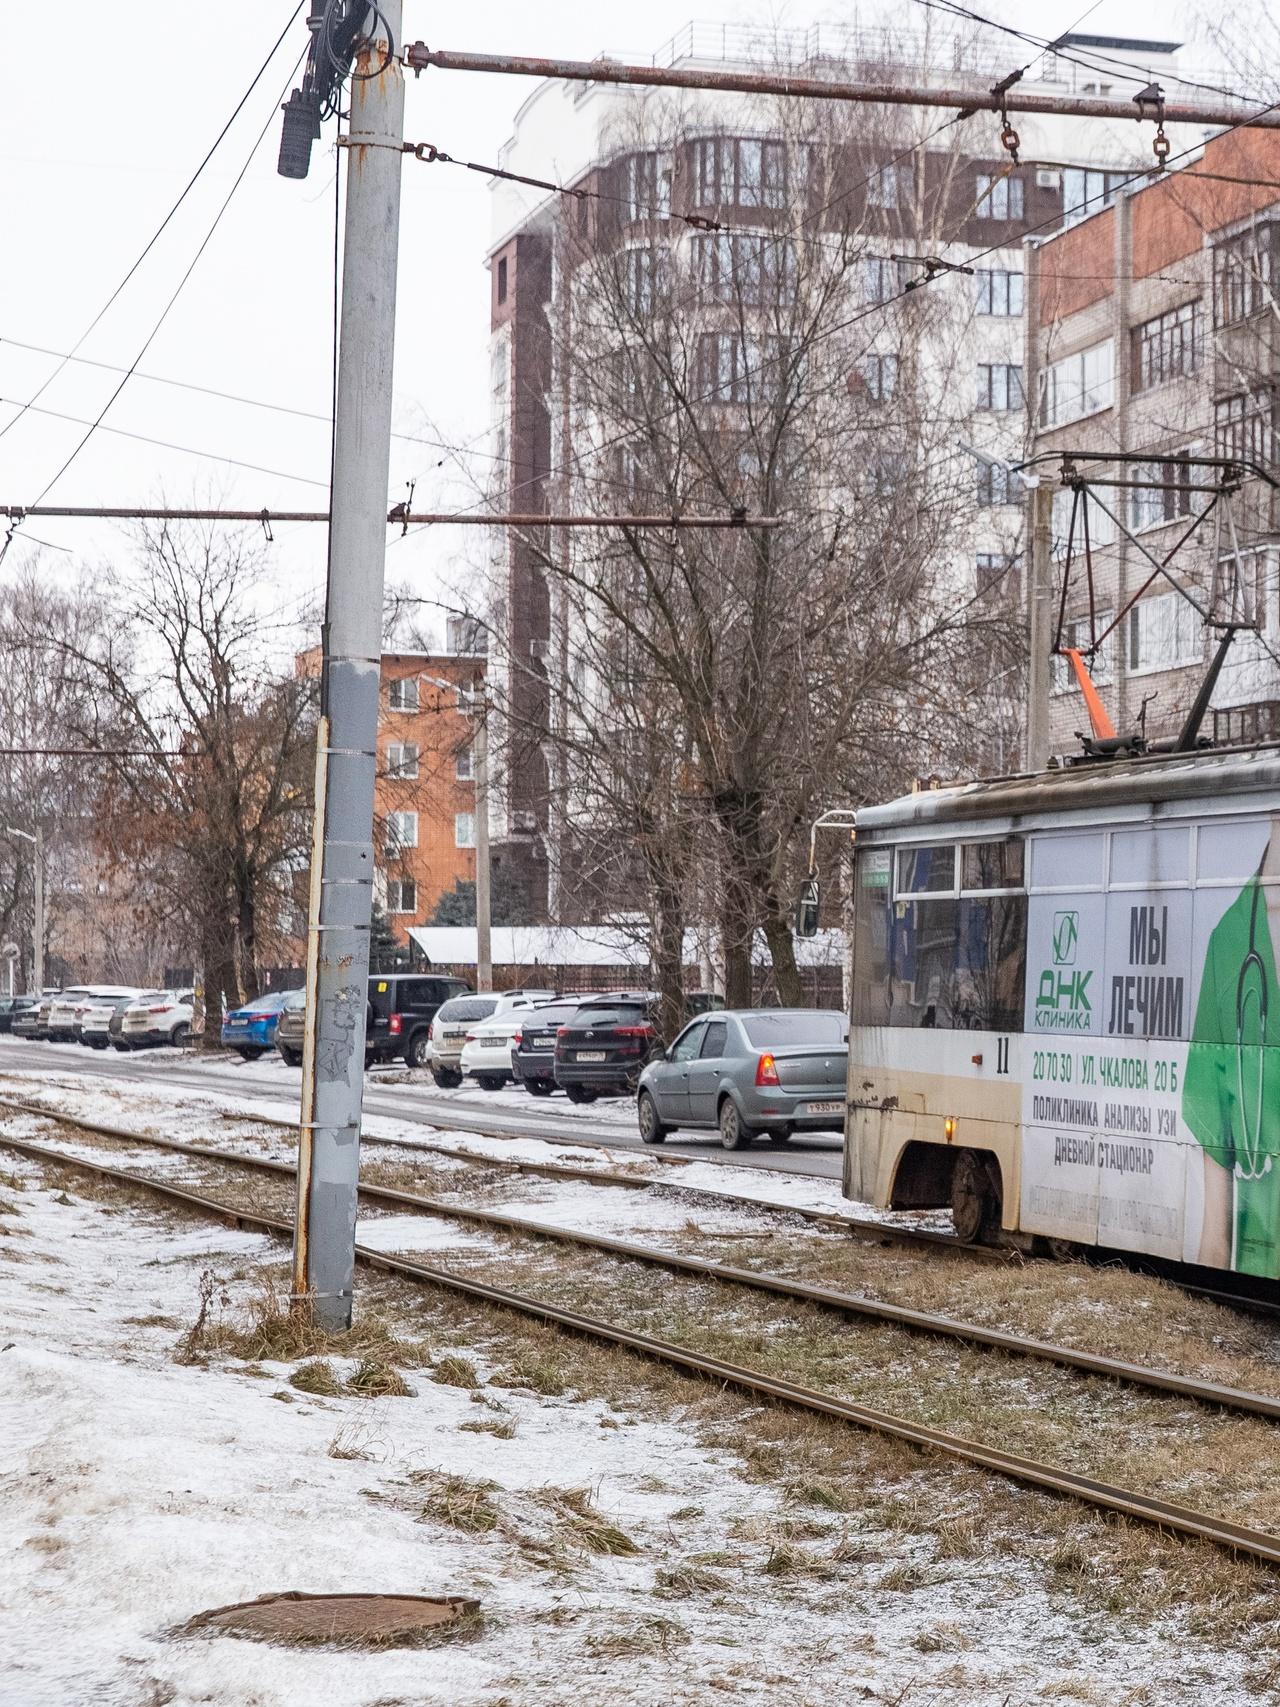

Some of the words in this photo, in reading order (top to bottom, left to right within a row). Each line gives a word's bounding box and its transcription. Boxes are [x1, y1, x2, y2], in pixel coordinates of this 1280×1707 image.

[1129, 906, 1168, 965] МЫ
[1036, 970, 1094, 1010] ДНК
[1109, 975, 1184, 1037] ЛЕЧИМ
[1034, 1010, 1091, 1030] КЛИНИКА
[996, 1037, 1009, 1074] 11
[1033, 1051, 1044, 1081] 20
[1046, 1052, 1057, 1082] 70
[1060, 1053, 1072, 1083] 30
[1082, 1055, 1097, 1086] УЛ.
[1100, 1056, 1149, 1090] ЧКАЛОВА
[1154, 1062, 1167, 1092] 20
[1170, 1062, 1178, 1093] Б
[1033, 1095, 1099, 1127] ПОЛИКЛИНИКА
[1104, 1103, 1151, 1133] АНАЛИЗЫ
[1157, 1108, 1177, 1136] УЗИ
[1054, 1136, 1095, 1167] ДНЕВНОЙ
[1098, 1142, 1154, 1175] СТАЦИОНАР
